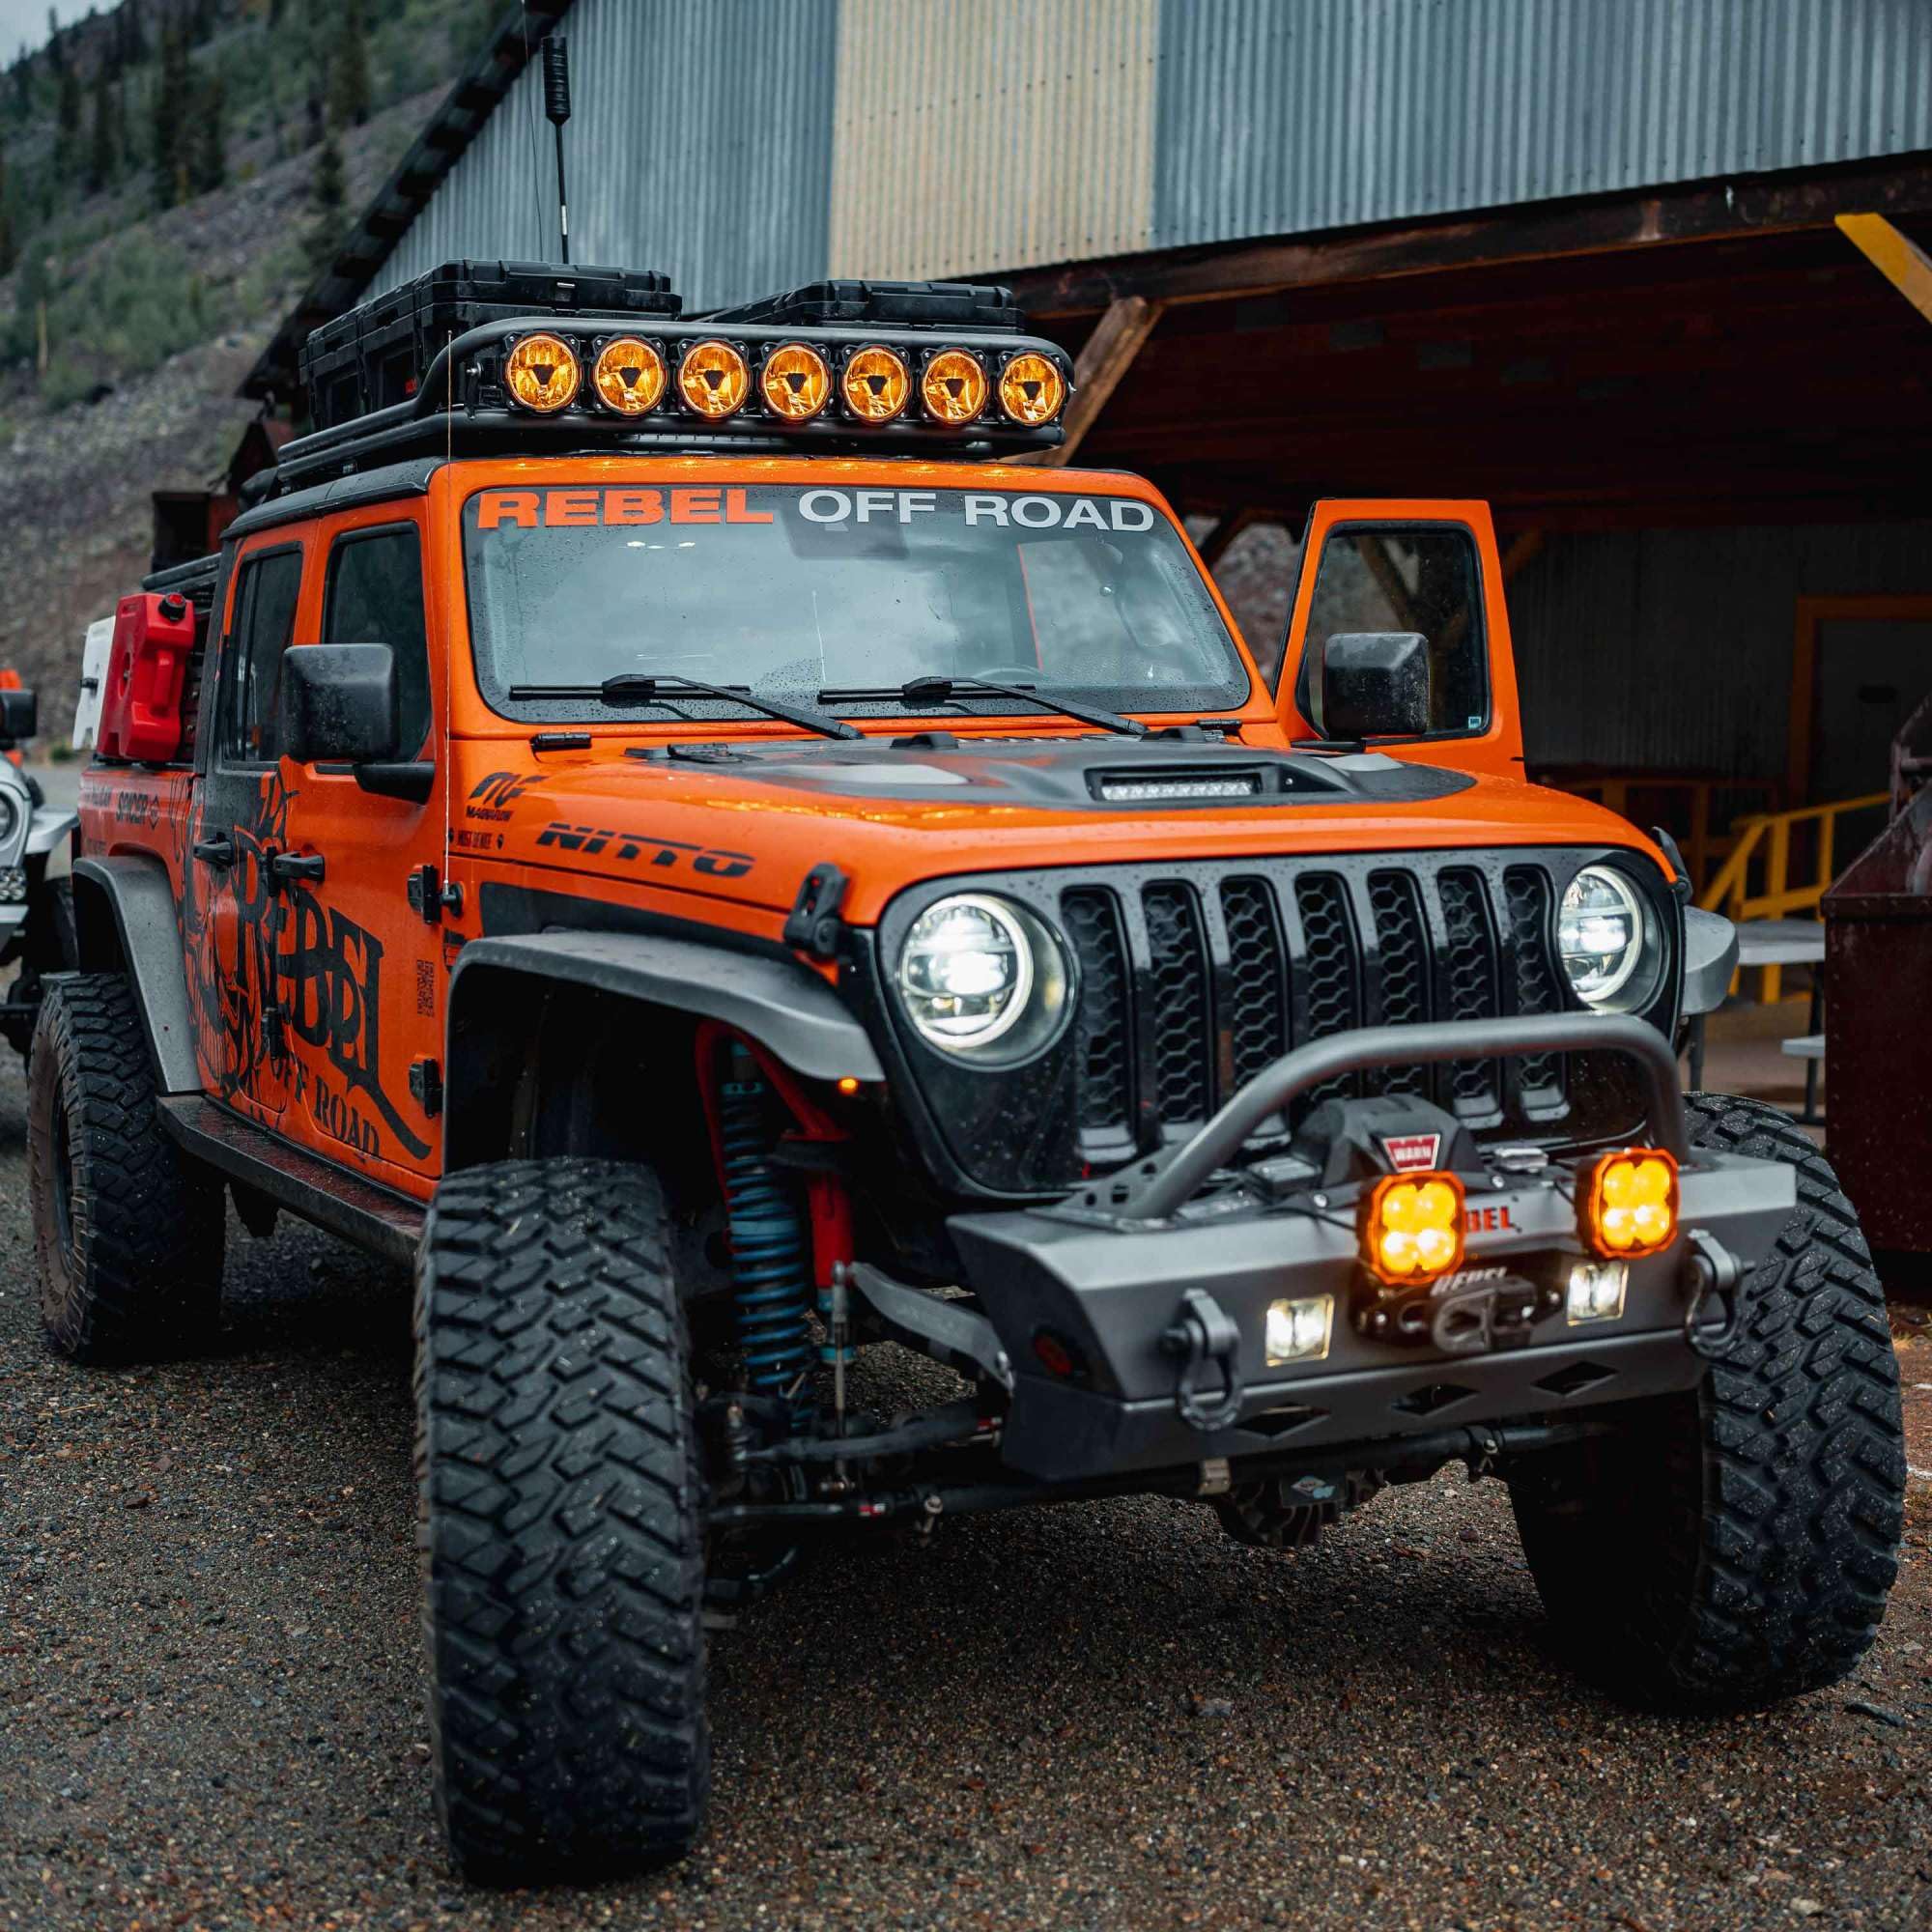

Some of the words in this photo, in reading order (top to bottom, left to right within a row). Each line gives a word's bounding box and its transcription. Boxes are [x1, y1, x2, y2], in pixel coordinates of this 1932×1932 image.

[478, 488, 774, 528] REBEL
[798, 489, 937, 524] OFF
[965, 494, 1154, 532] ROAD
[537, 822, 758, 878] NITTO
[314, 1073, 380, 1162] ROAD
[1393, 1145, 1433, 1162] WARN
